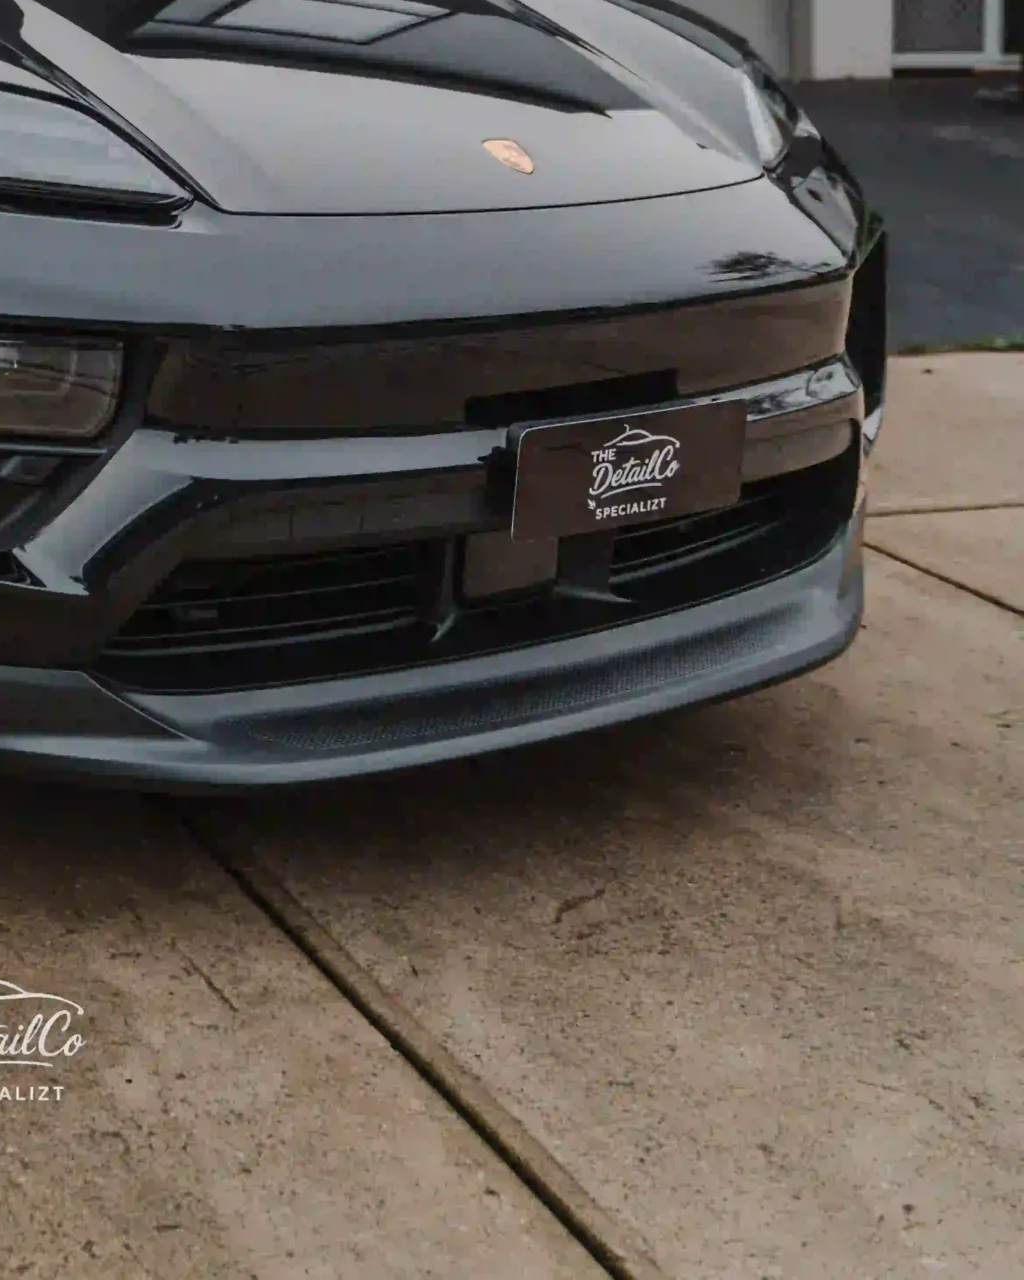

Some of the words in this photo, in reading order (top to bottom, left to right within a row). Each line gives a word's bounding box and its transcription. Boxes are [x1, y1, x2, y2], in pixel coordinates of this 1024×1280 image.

[591, 448, 617, 463] THE
[589, 445, 680, 496] DetailCo
[595, 497, 667, 520] SPECIALIZT
